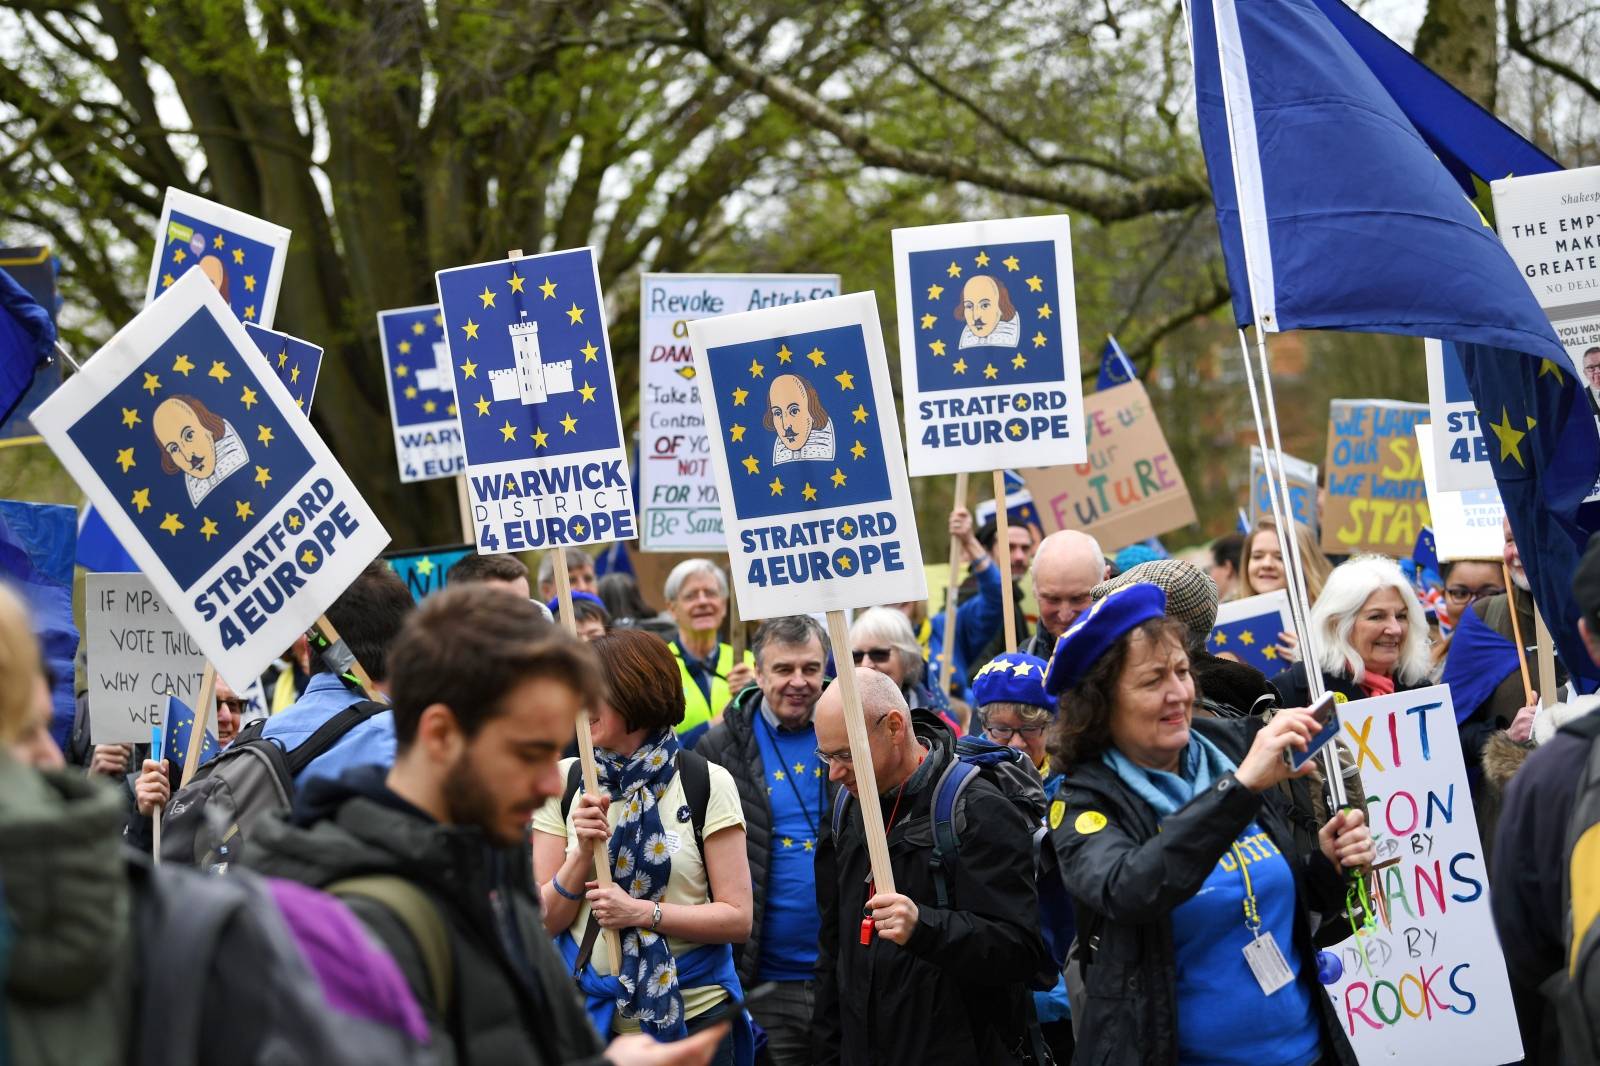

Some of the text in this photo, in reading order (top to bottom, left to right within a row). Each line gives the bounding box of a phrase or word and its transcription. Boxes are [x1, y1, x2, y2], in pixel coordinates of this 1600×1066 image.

[1512, 222, 1547, 238] THE
[1546, 278, 1599, 294] NO DEAL
[651, 287, 724, 313] Revoke
[1558, 326, 1578, 337] YOU
[919, 390, 1068, 421] STRATFORD
[654, 435, 685, 454] OF
[921, 414, 1070, 449] 4EUROPE
[405, 462, 418, 478] 4
[471, 459, 627, 502] WARWICK
[677, 459, 709, 477] NOT
[475, 488, 628, 522] DISTRICT
[652, 484, 691, 503] FOR
[480, 508, 634, 551] 4 EUROPE
[650, 511, 679, 538] Be
[740, 511, 897, 553] STRATFORD
[194, 477, 335, 623] STRATFORD
[218, 500, 361, 652] 4EUROPE
[748, 540, 905, 588] 4EUROPE
[100, 590, 116, 612] IF
[126, 590, 160, 614] MPs
[110, 628, 156, 654] VOTE
[100, 671, 140, 692] WHY
[129, 703, 162, 726] WE
[1410, 832, 1434, 857] BY
[1403, 926, 1438, 958] BY
